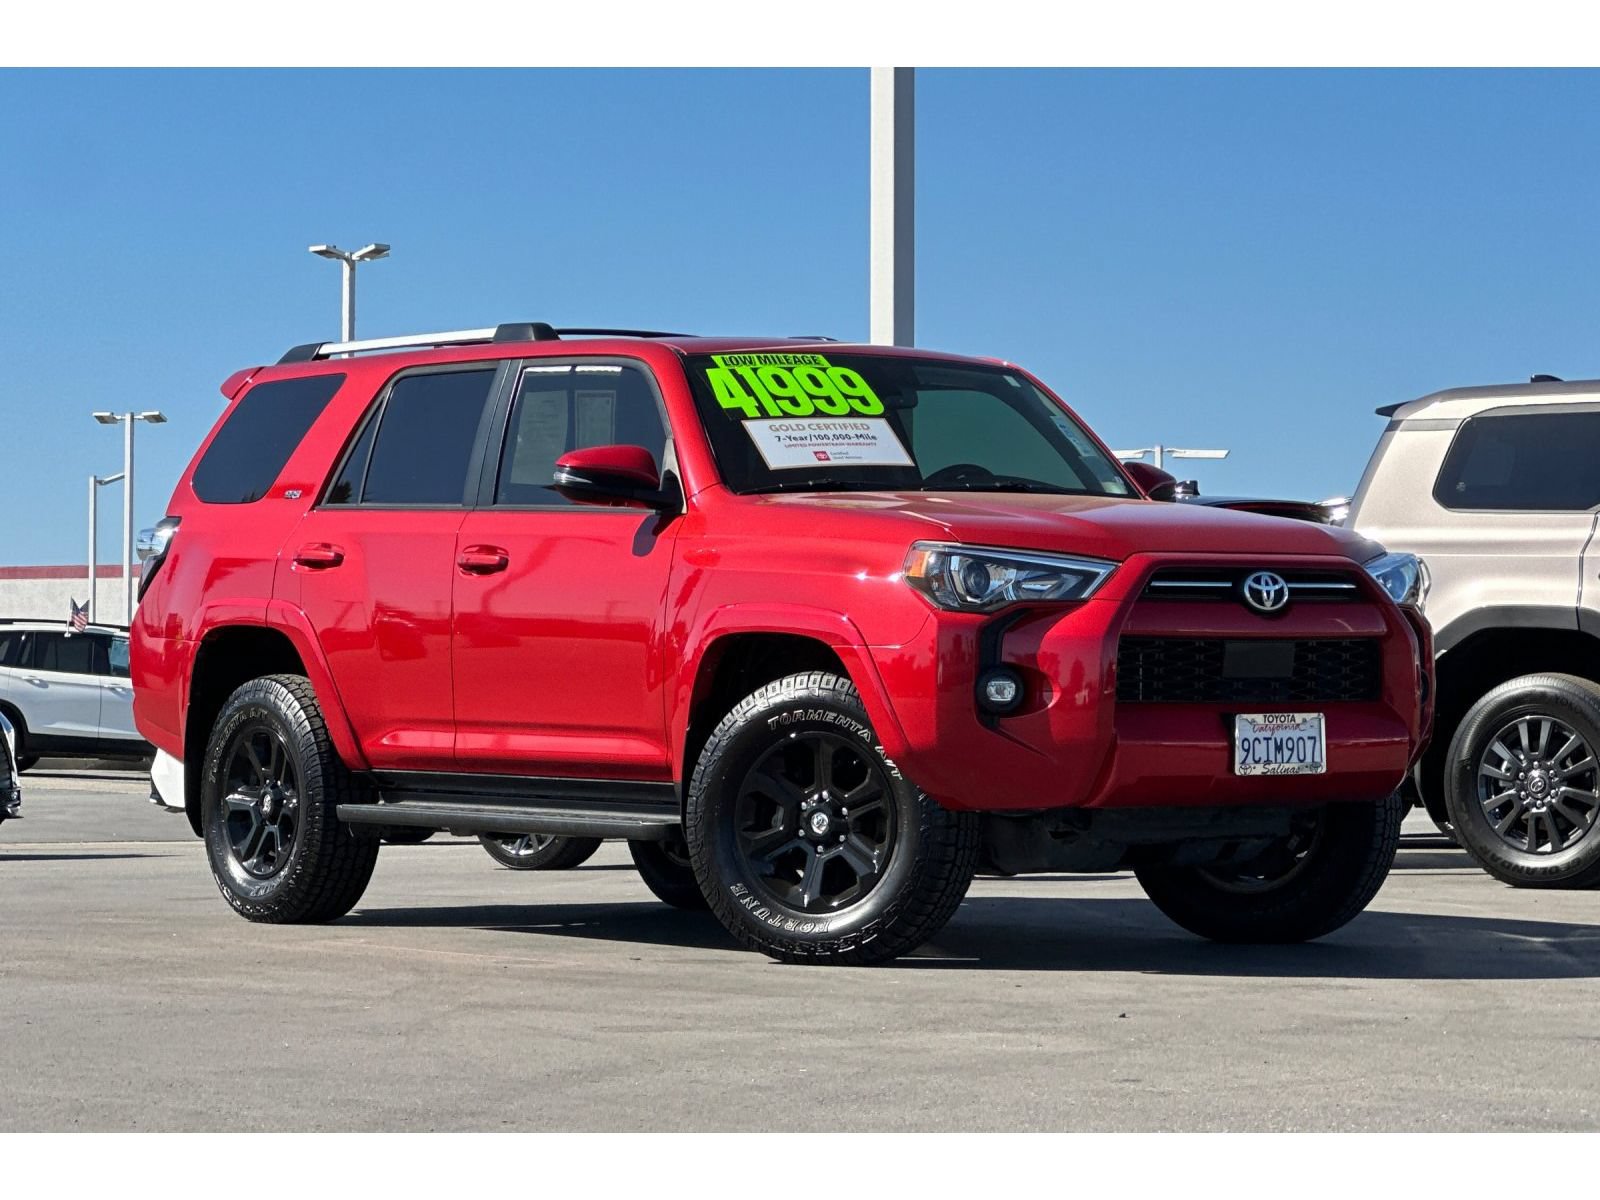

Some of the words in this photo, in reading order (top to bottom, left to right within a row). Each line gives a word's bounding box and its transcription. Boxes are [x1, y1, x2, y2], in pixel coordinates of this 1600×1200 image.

[721, 355, 756, 367] LOW
[757, 354, 820, 366] MILEAGE
[706, 366, 885, 417] 41999
[769, 423, 806, 432] GOLD
[807, 422, 870, 432] CERTIFIED
[775, 432, 878, 443] 7-Year/100,000-Mile
[1263, 714, 1296, 724] TOYOTA
[767, 709, 872, 743] TORMENTA
[1253, 723, 1304, 737] California
[1240, 736, 1317, 764] 9CIM907
[1261, 762, 1300, 775] Salinas
[730, 882, 833, 934] FORTUNE
